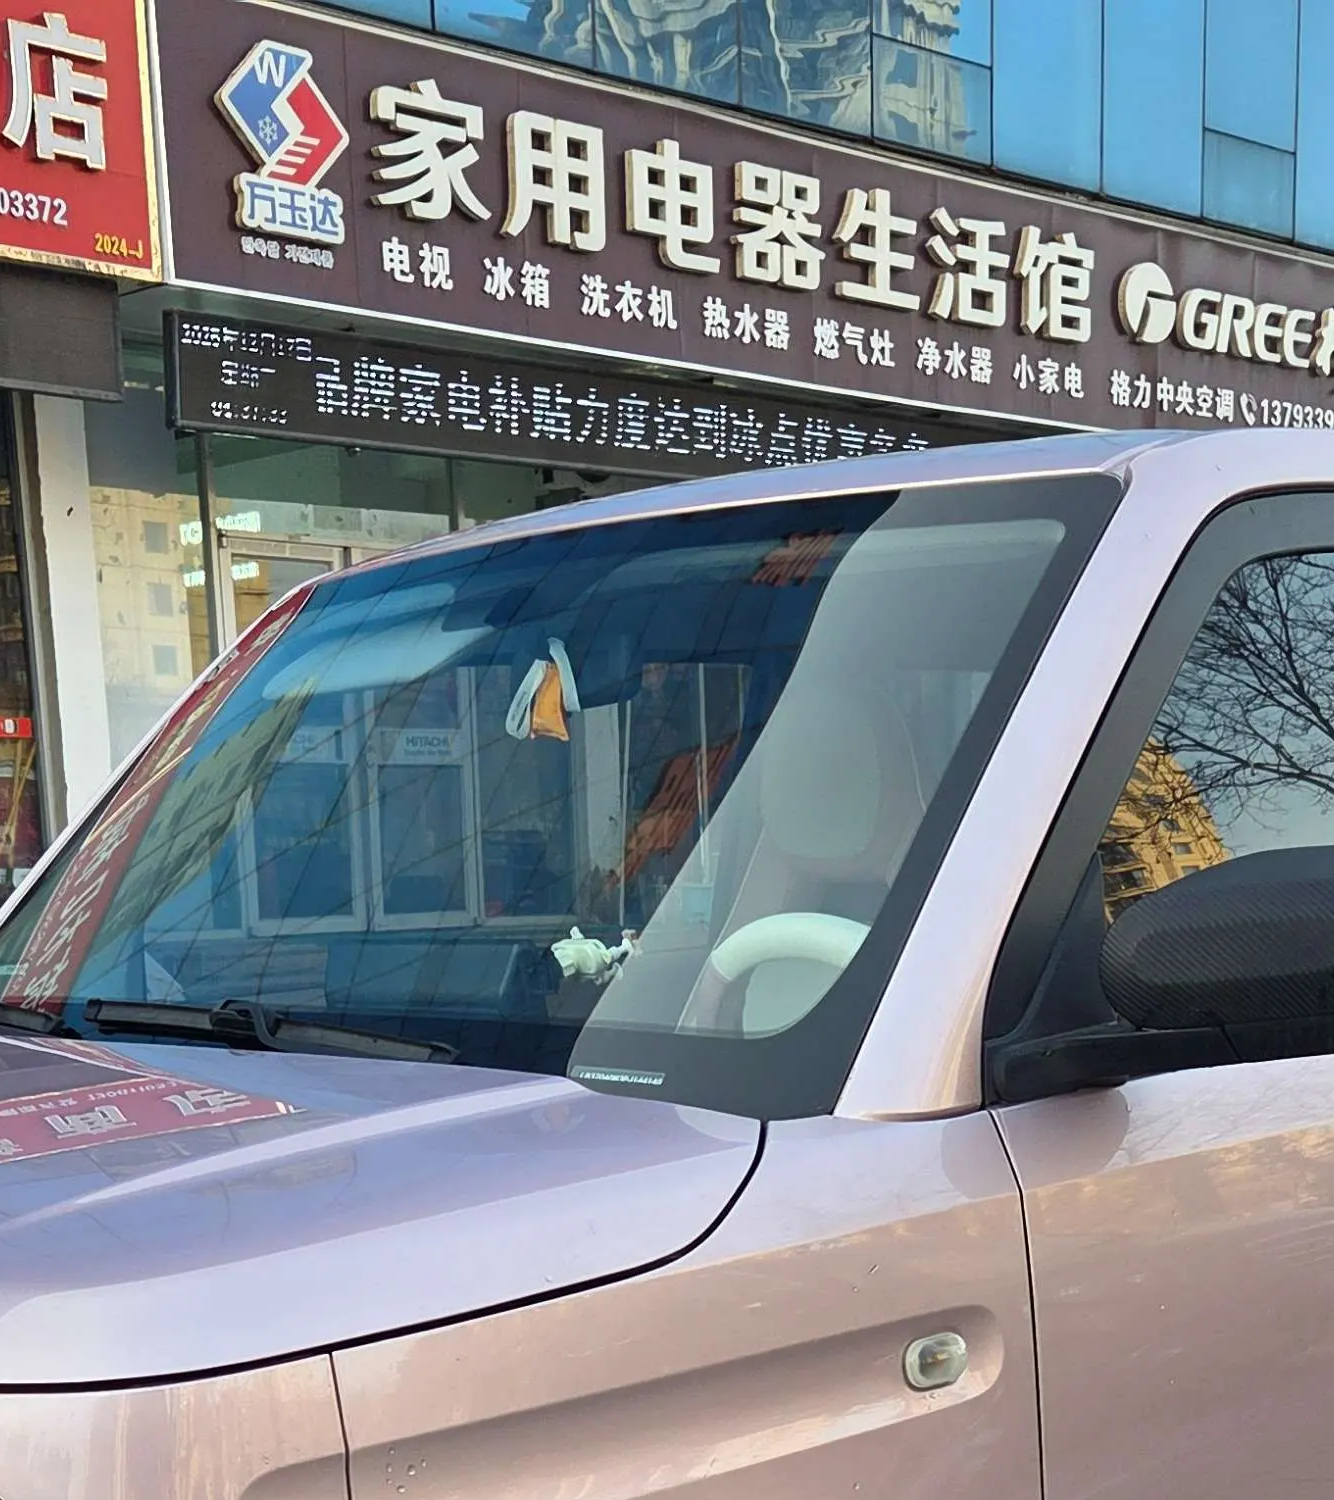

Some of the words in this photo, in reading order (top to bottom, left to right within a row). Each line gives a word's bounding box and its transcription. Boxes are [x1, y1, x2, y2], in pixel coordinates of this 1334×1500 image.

[246, 180, 339, 237] 万玉达
[368, 78, 1094, 343] 家用电器生活馆
[381, 237, 454, 291] 电视
[482, 256, 551, 309] 冰箱
[579, 274, 677, 330] 洗衣机
[702, 296, 790, 351] 热水器
[813, 316, 896, 368] 燃气灶
[915, 336, 993, 385] 净水器
[1012, 353, 1084, 399] 小家电
[1177, 288, 1317, 369] GREE
[1110, 369, 1234, 423] 格力中央空调
